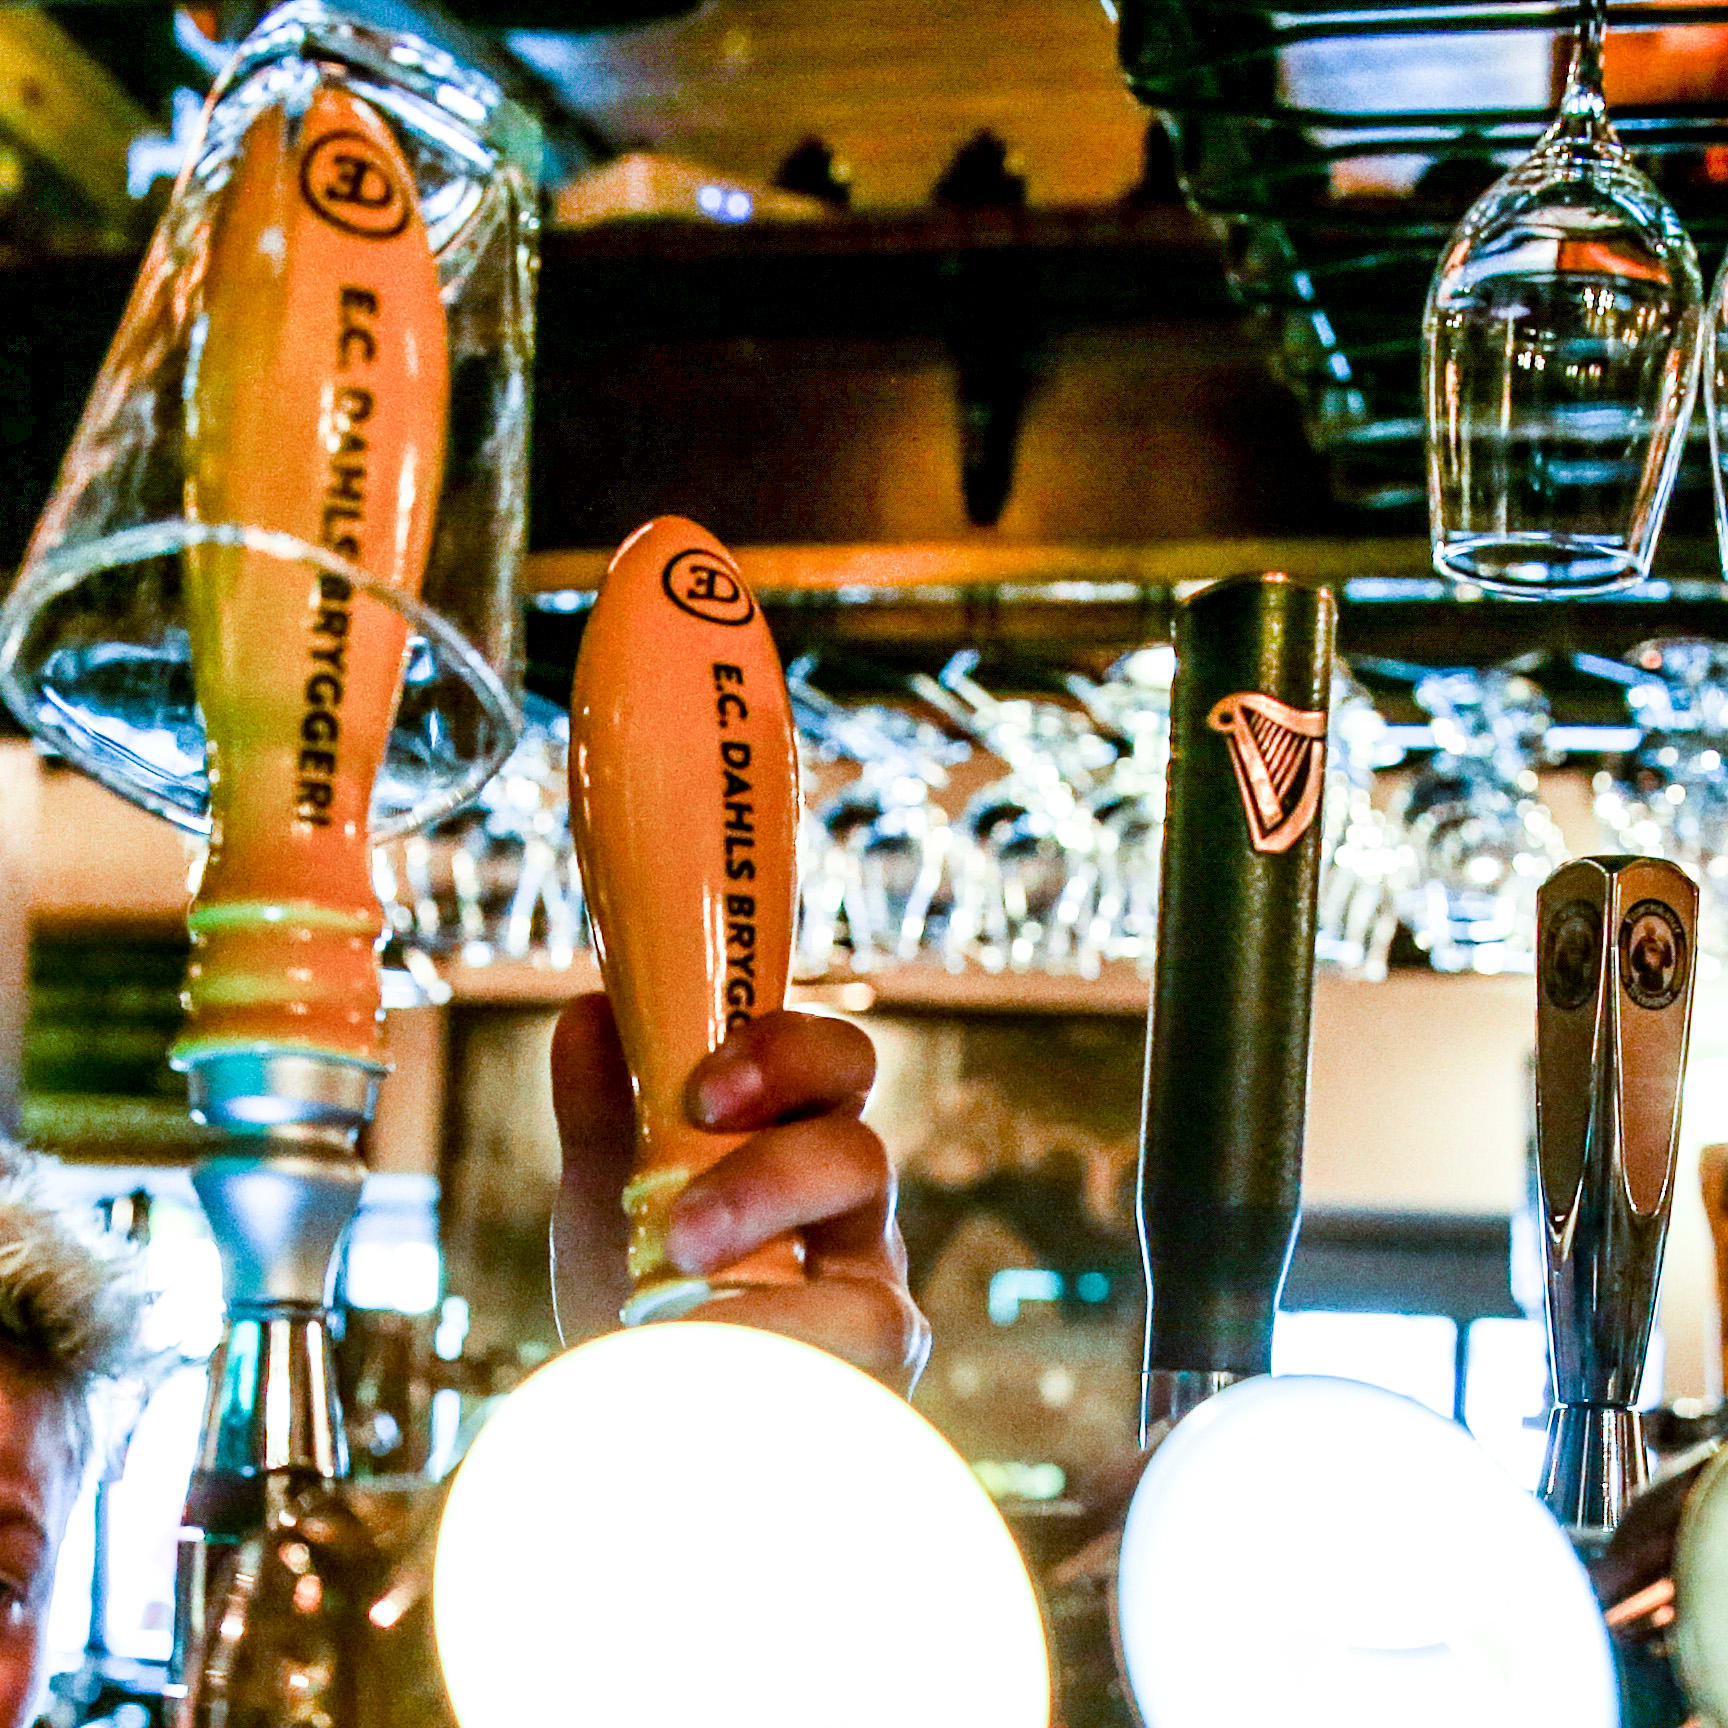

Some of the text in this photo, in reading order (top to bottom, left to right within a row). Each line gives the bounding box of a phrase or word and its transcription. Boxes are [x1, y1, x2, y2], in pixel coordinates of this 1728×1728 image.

[296, 572, 354, 828] BRYGGERI
[712, 662, 749, 729] E.C.
[721, 741, 756, 880] DAHLS
